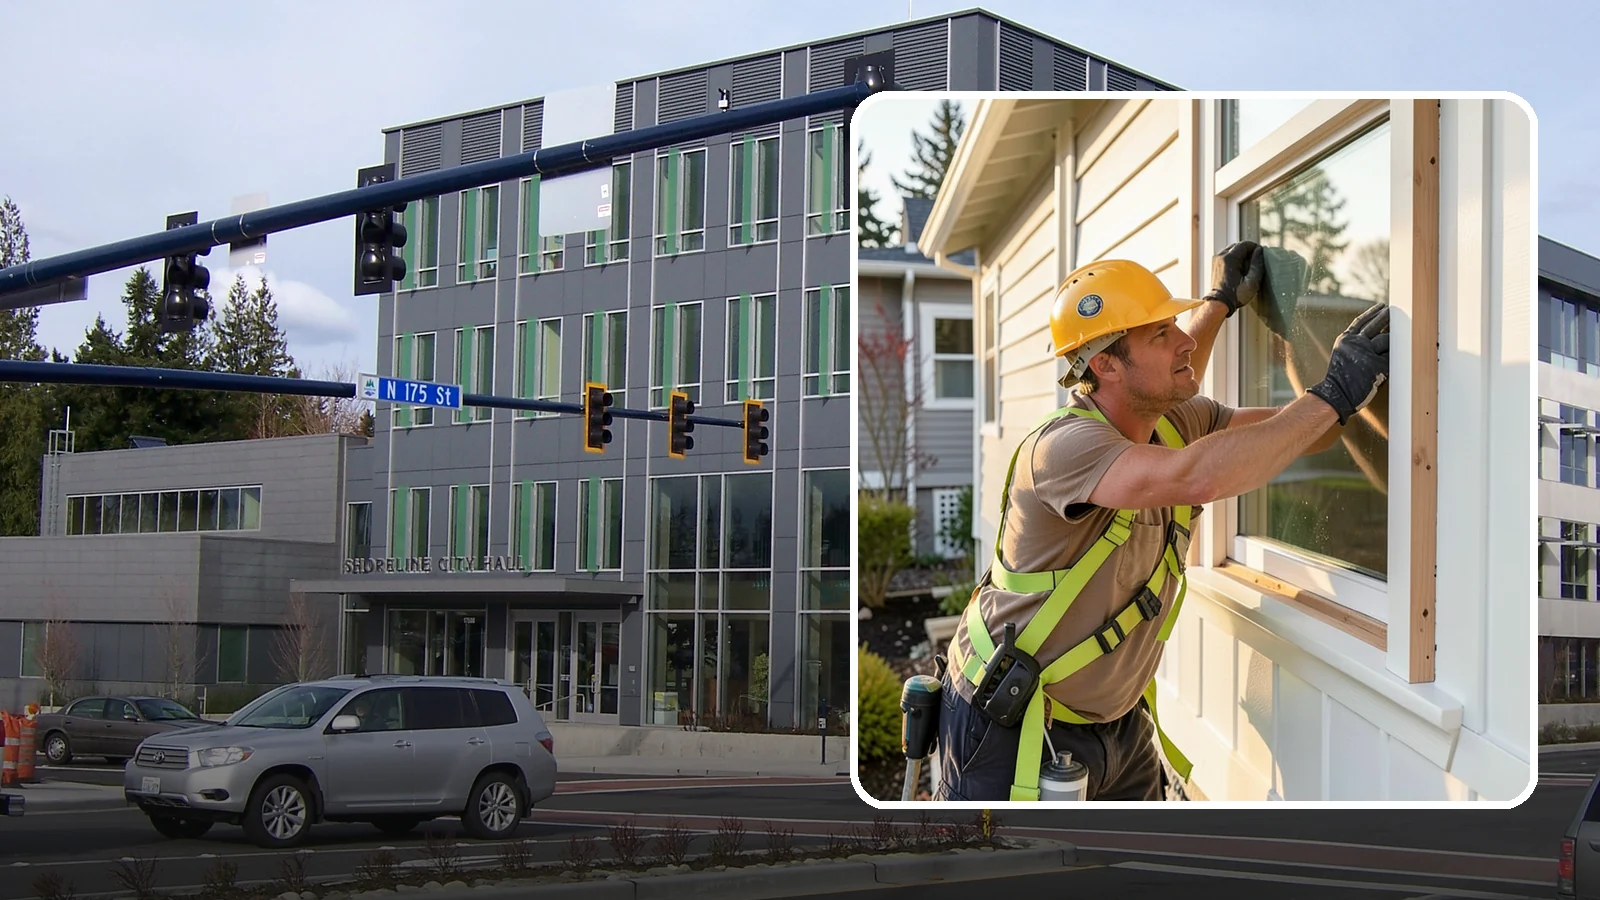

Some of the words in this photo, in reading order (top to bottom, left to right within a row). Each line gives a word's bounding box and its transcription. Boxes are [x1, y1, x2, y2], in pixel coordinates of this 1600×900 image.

[387, 380, 396, 400] N
[405, 382, 428, 403] 175
[436, 386, 451, 406] St
[344, 557, 432, 574] SHORELINE
[438, 556, 476, 572] CITY
[483, 556, 526, 572] HALL
